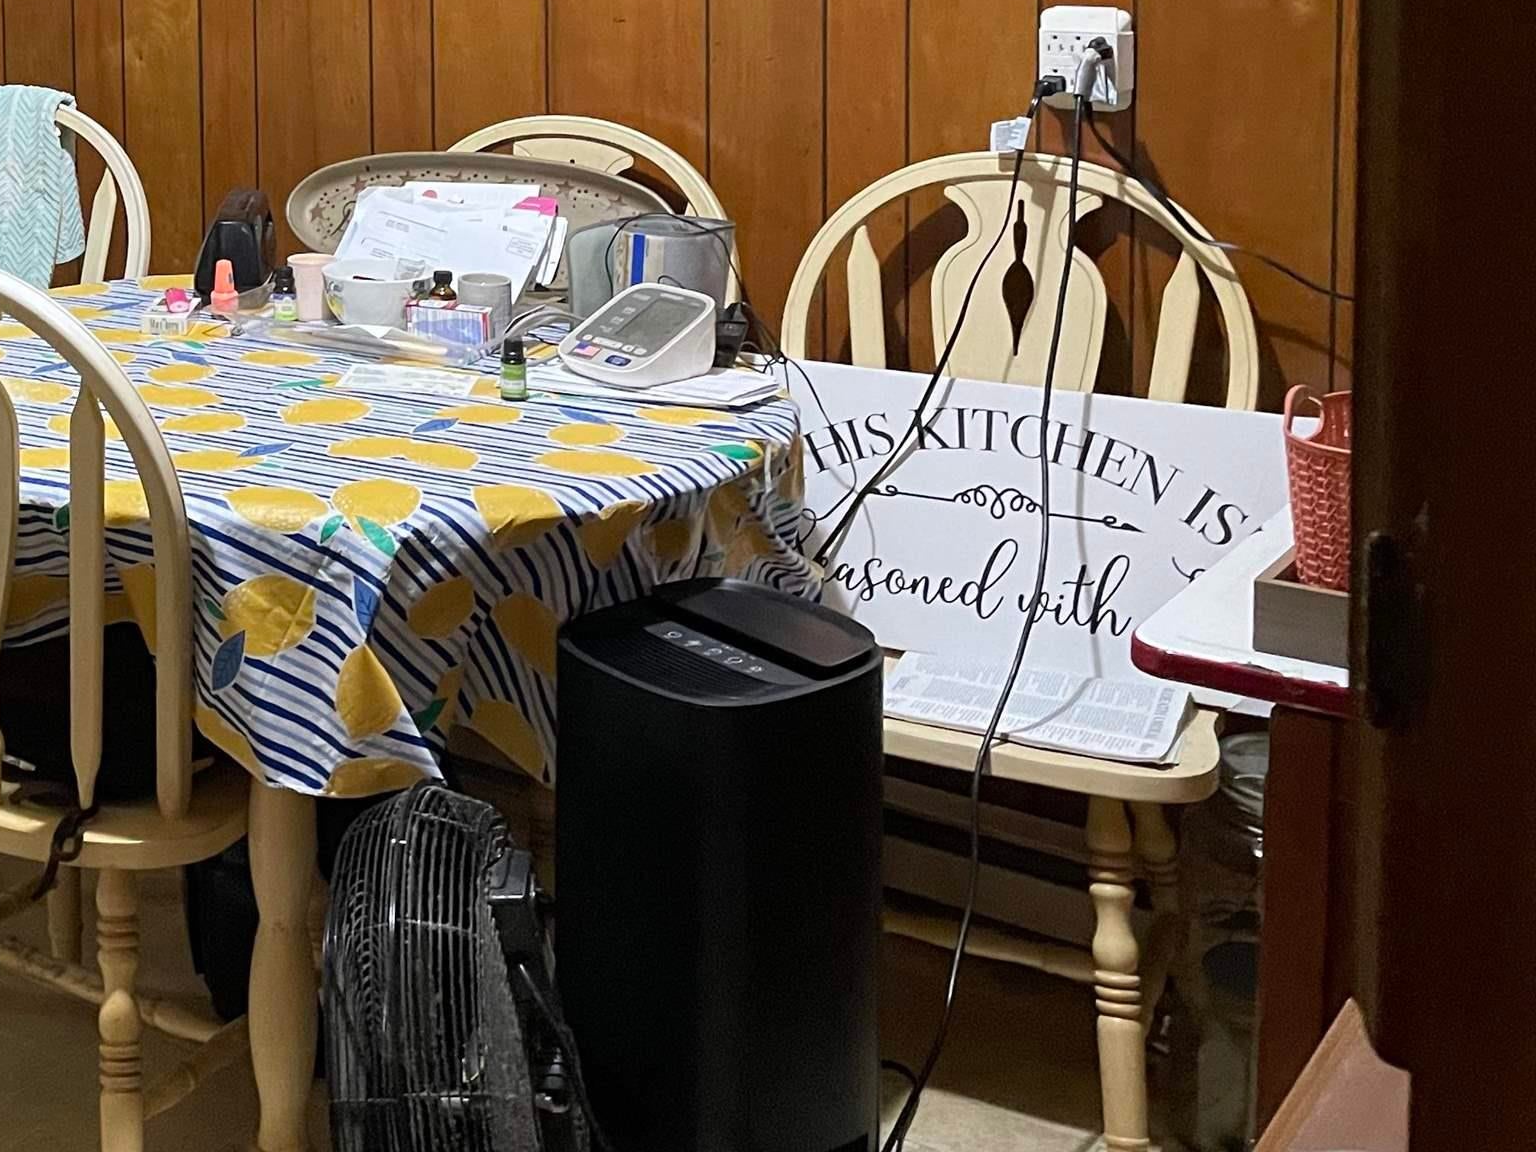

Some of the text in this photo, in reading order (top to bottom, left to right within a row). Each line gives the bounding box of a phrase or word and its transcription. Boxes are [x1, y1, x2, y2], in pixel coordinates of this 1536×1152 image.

[803, 407, 1250, 546] HIS KITCHEN IS
[821, 538, 1133, 637] asoned with
